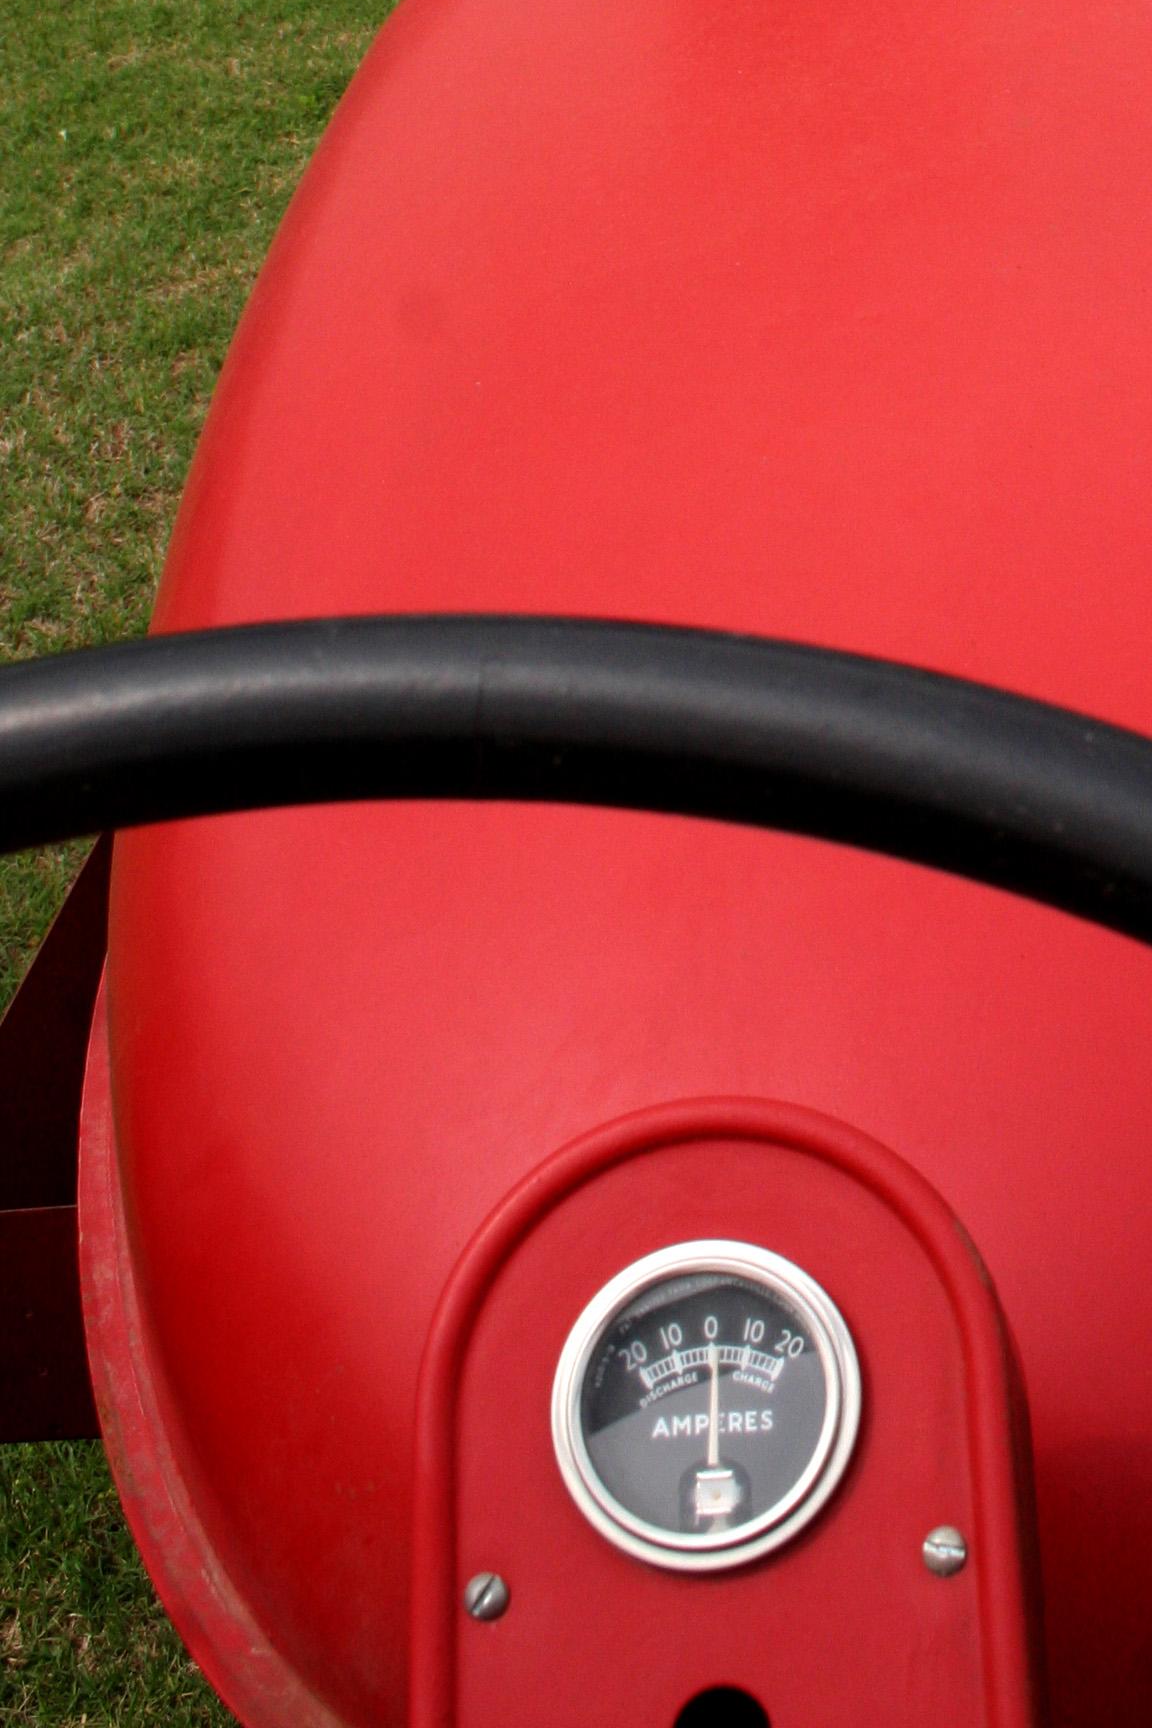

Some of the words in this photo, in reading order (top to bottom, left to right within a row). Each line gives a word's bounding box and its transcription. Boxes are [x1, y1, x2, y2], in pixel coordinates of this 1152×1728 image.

[618, 1339, 648, 1371] 20
[660, 1322, 683, 1350] 10
[704, 1315, 719, 1340] 0
[744, 1317, 765, 1342] 10
[774, 1328, 804, 1359] 20
[639, 1371, 698, 1409] DISCHARGE
[732, 1369, 775, 1394] CHARGE
